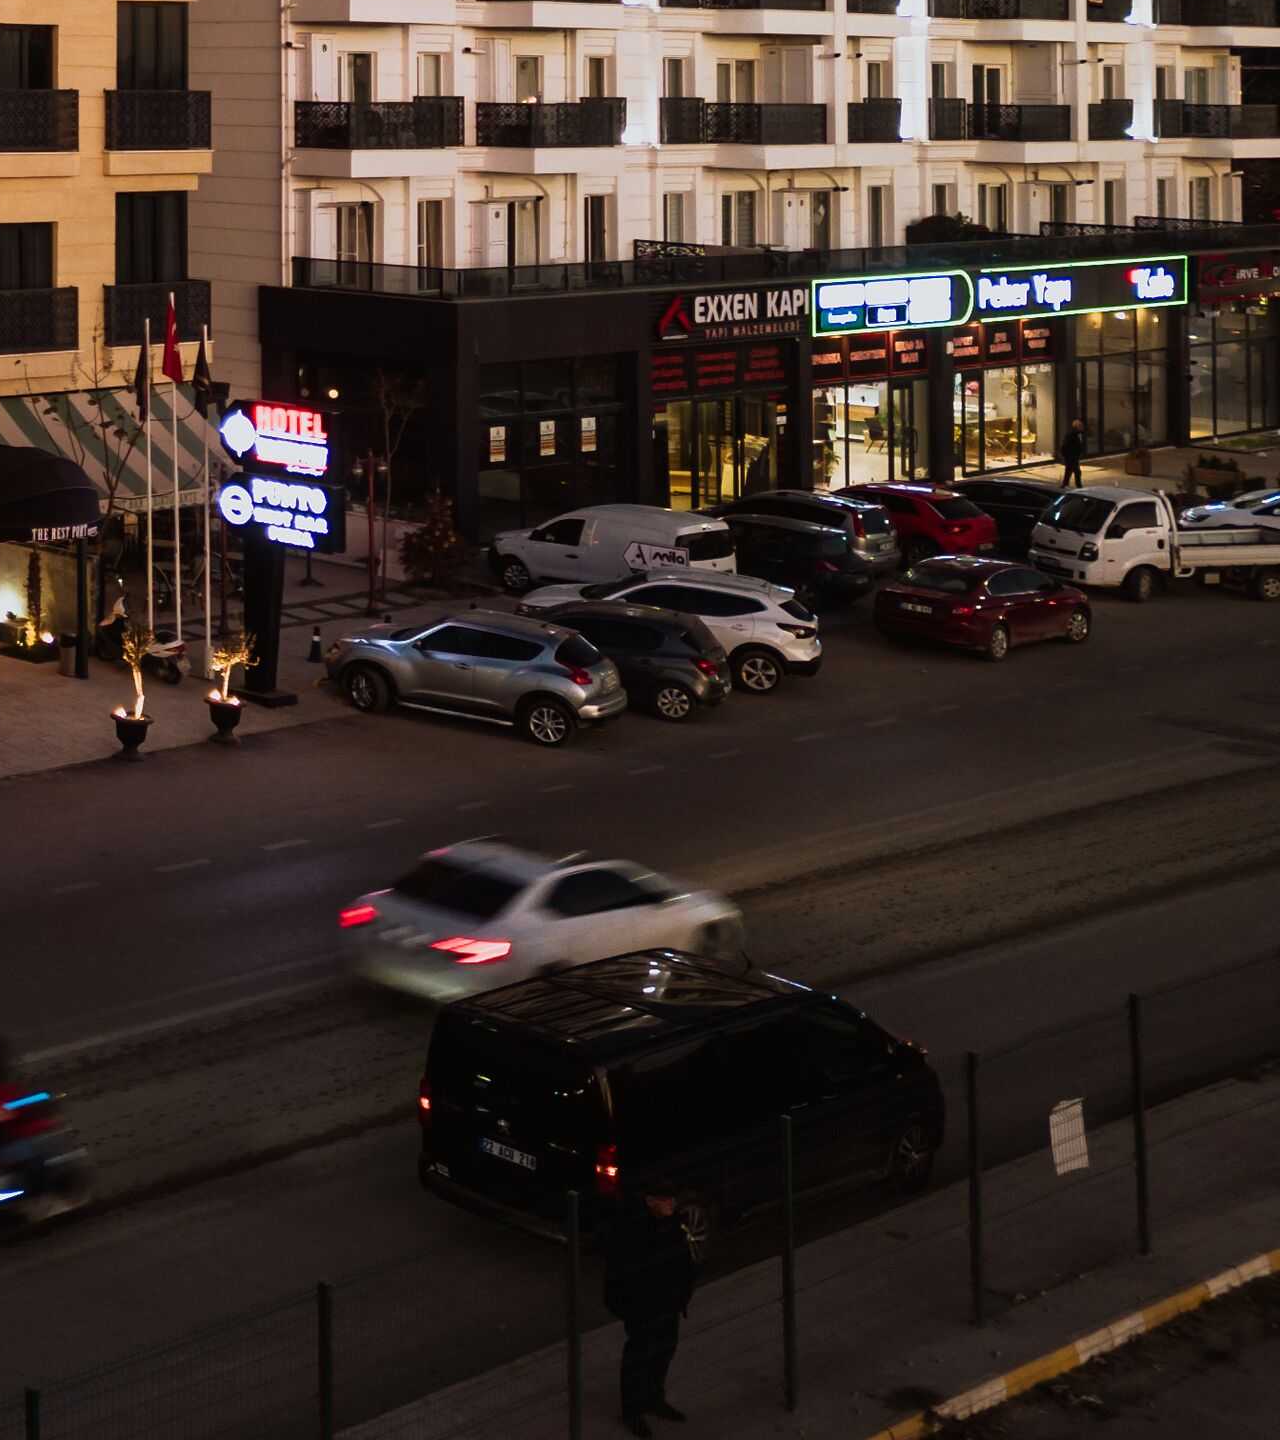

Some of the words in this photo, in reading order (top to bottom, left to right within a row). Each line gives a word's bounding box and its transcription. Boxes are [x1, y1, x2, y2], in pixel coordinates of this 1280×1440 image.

[694, 292, 758, 324] EXXEN
[767, 288, 810, 318] KAPI
[255, 405, 328, 439] HOTEL
[31, 527, 49, 542] THE
